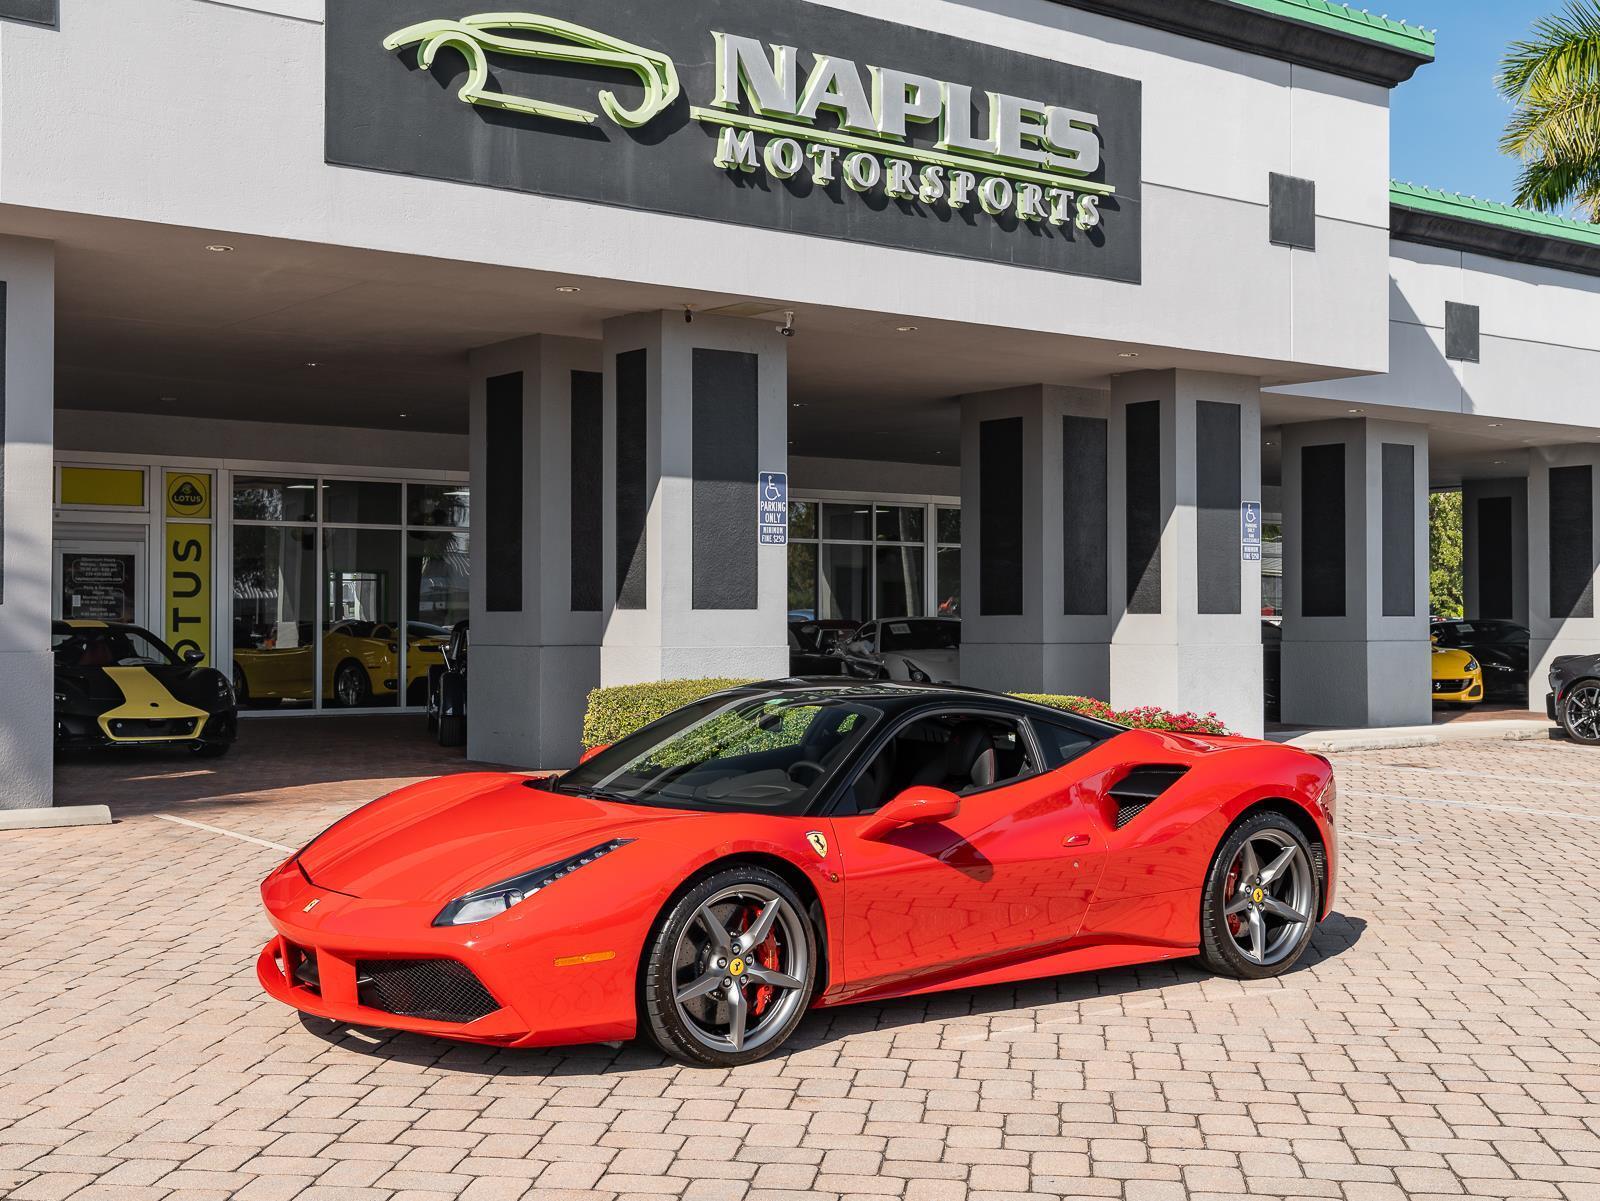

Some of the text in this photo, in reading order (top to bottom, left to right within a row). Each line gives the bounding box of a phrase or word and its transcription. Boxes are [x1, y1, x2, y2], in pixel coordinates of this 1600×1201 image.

[710, 31, 1101, 176] NAPLES
[713, 126, 1100, 230] MOTORSPORTS
[760, 501, 786, 512] PARKING
[765, 513, 781, 523] ONLY
[763, 526, 783, 534] MINIMUM
[761, 534, 784, 543] FINE $250
[173, 539, 202, 664] OTUS
